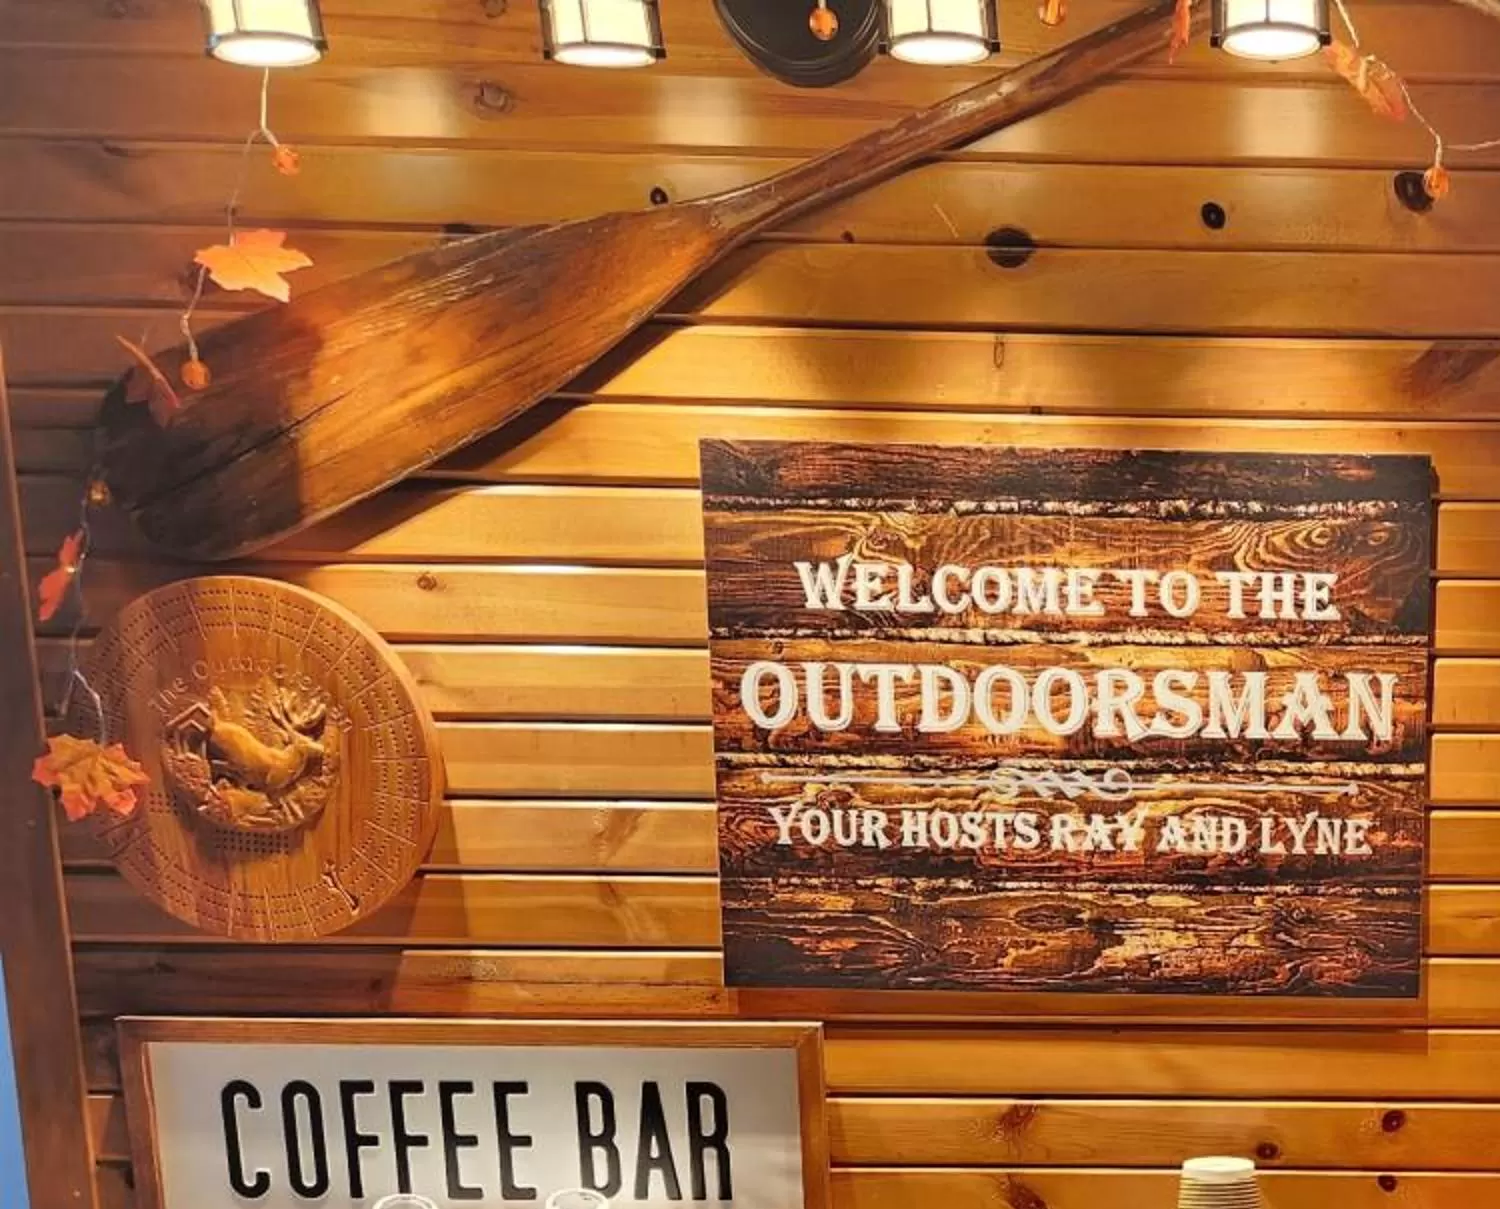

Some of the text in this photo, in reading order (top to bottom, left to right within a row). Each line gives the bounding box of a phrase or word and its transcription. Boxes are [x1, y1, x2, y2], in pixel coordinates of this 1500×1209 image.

[793, 552, 1342, 621] WELCOME TO THE
[739, 660, 1399, 743] OUTDOORSMAN
[766, 802, 1374, 856] YOUR HOSTS RAY AND LYNE
[219, 1078, 734, 1202] COFFEE BAR
